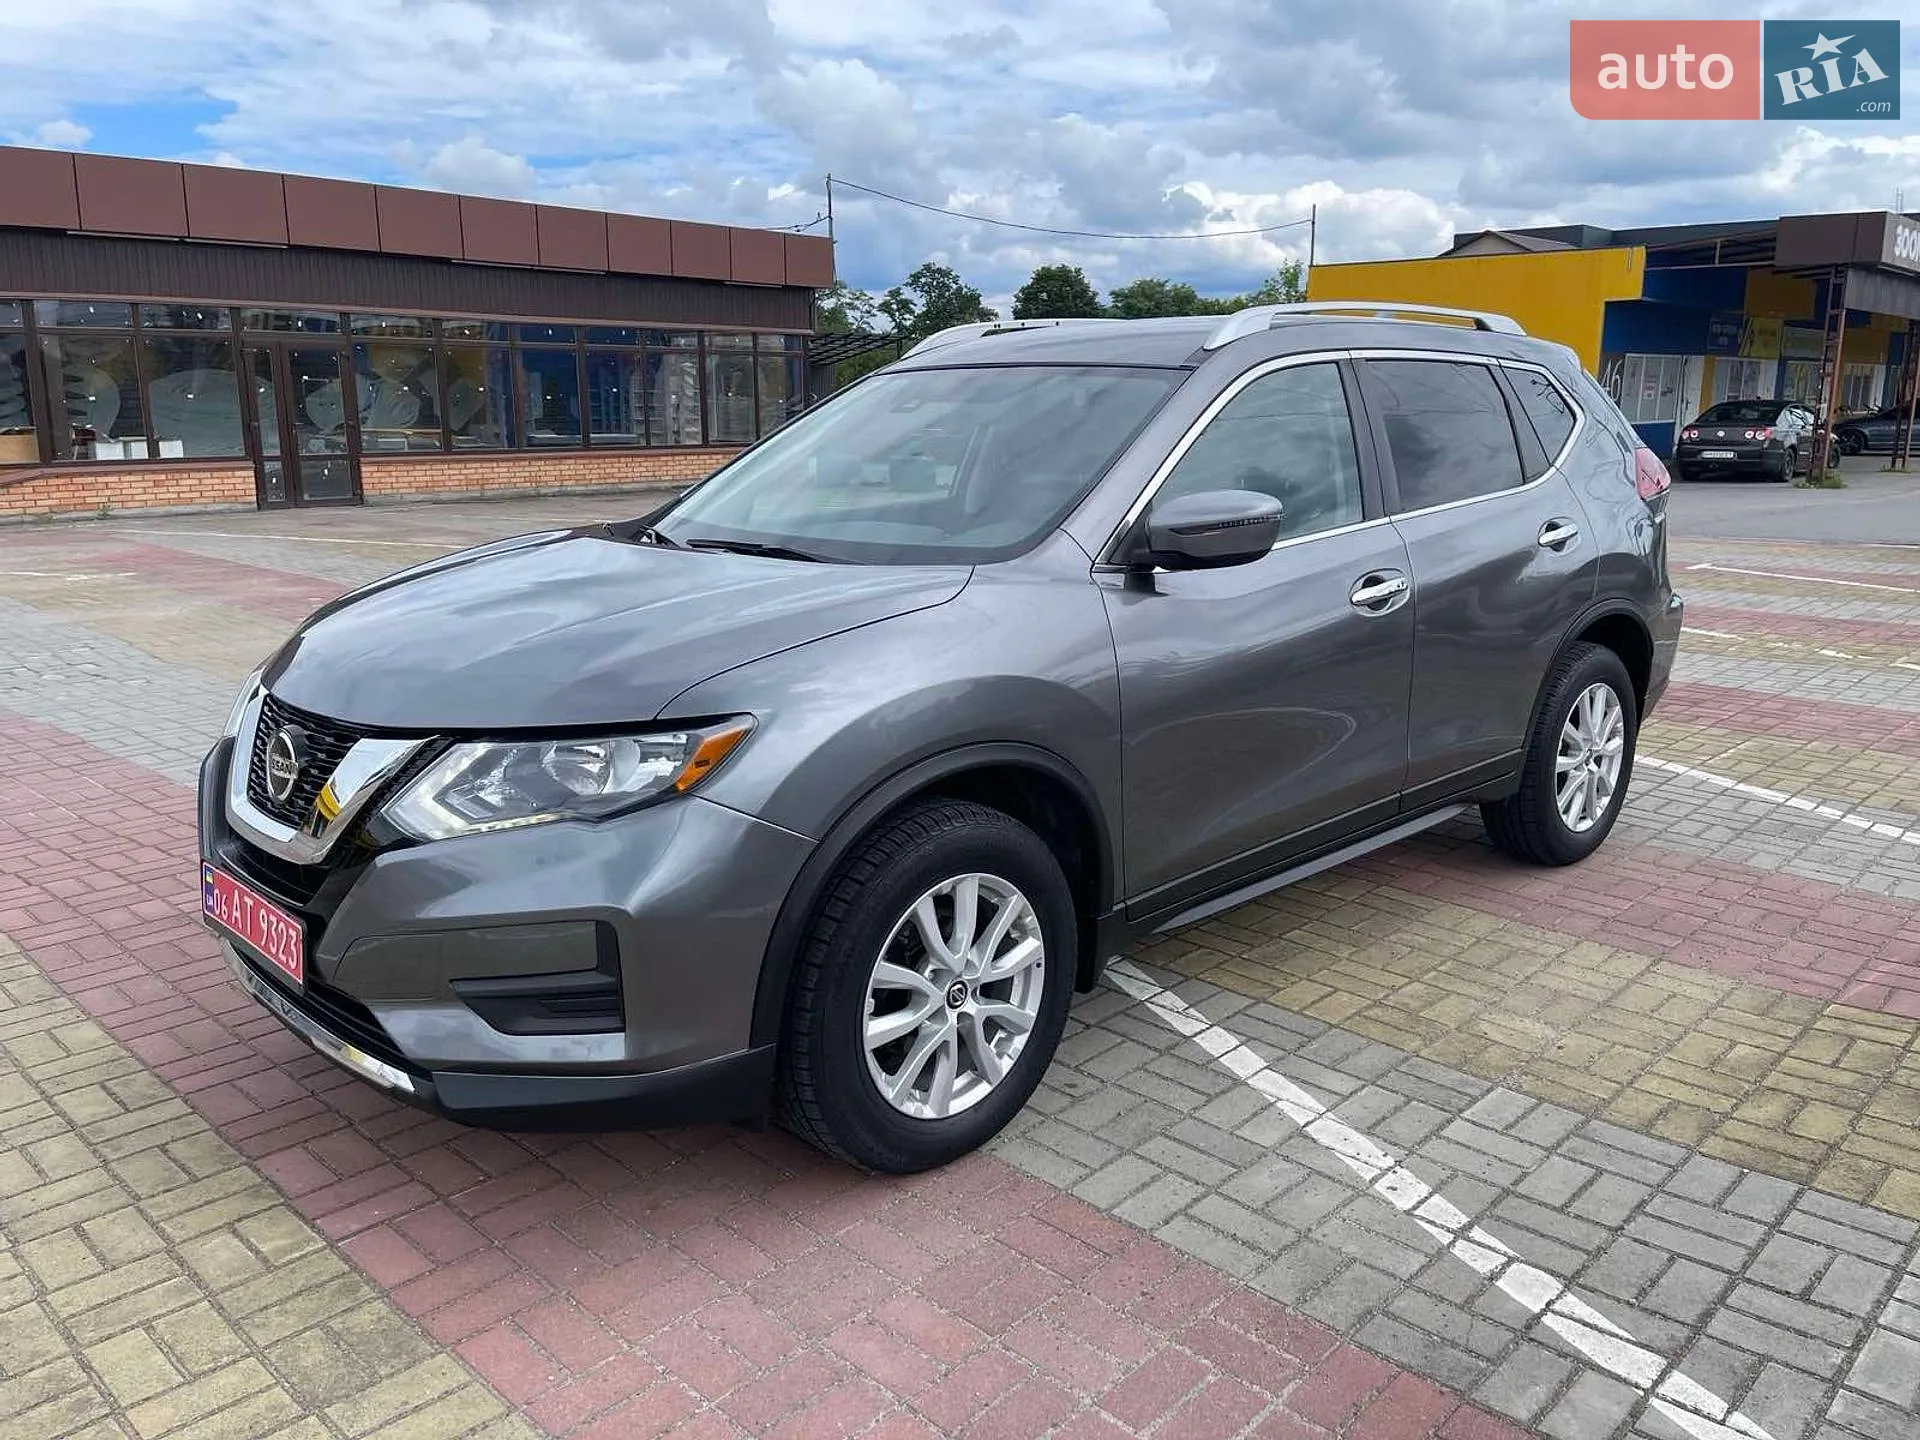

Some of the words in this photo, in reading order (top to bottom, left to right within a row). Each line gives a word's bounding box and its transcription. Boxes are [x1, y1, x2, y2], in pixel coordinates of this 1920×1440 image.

[213, 888, 228, 920] 06
[231, 889, 254, 937] AT
[259, 908, 298, 970] 9323
